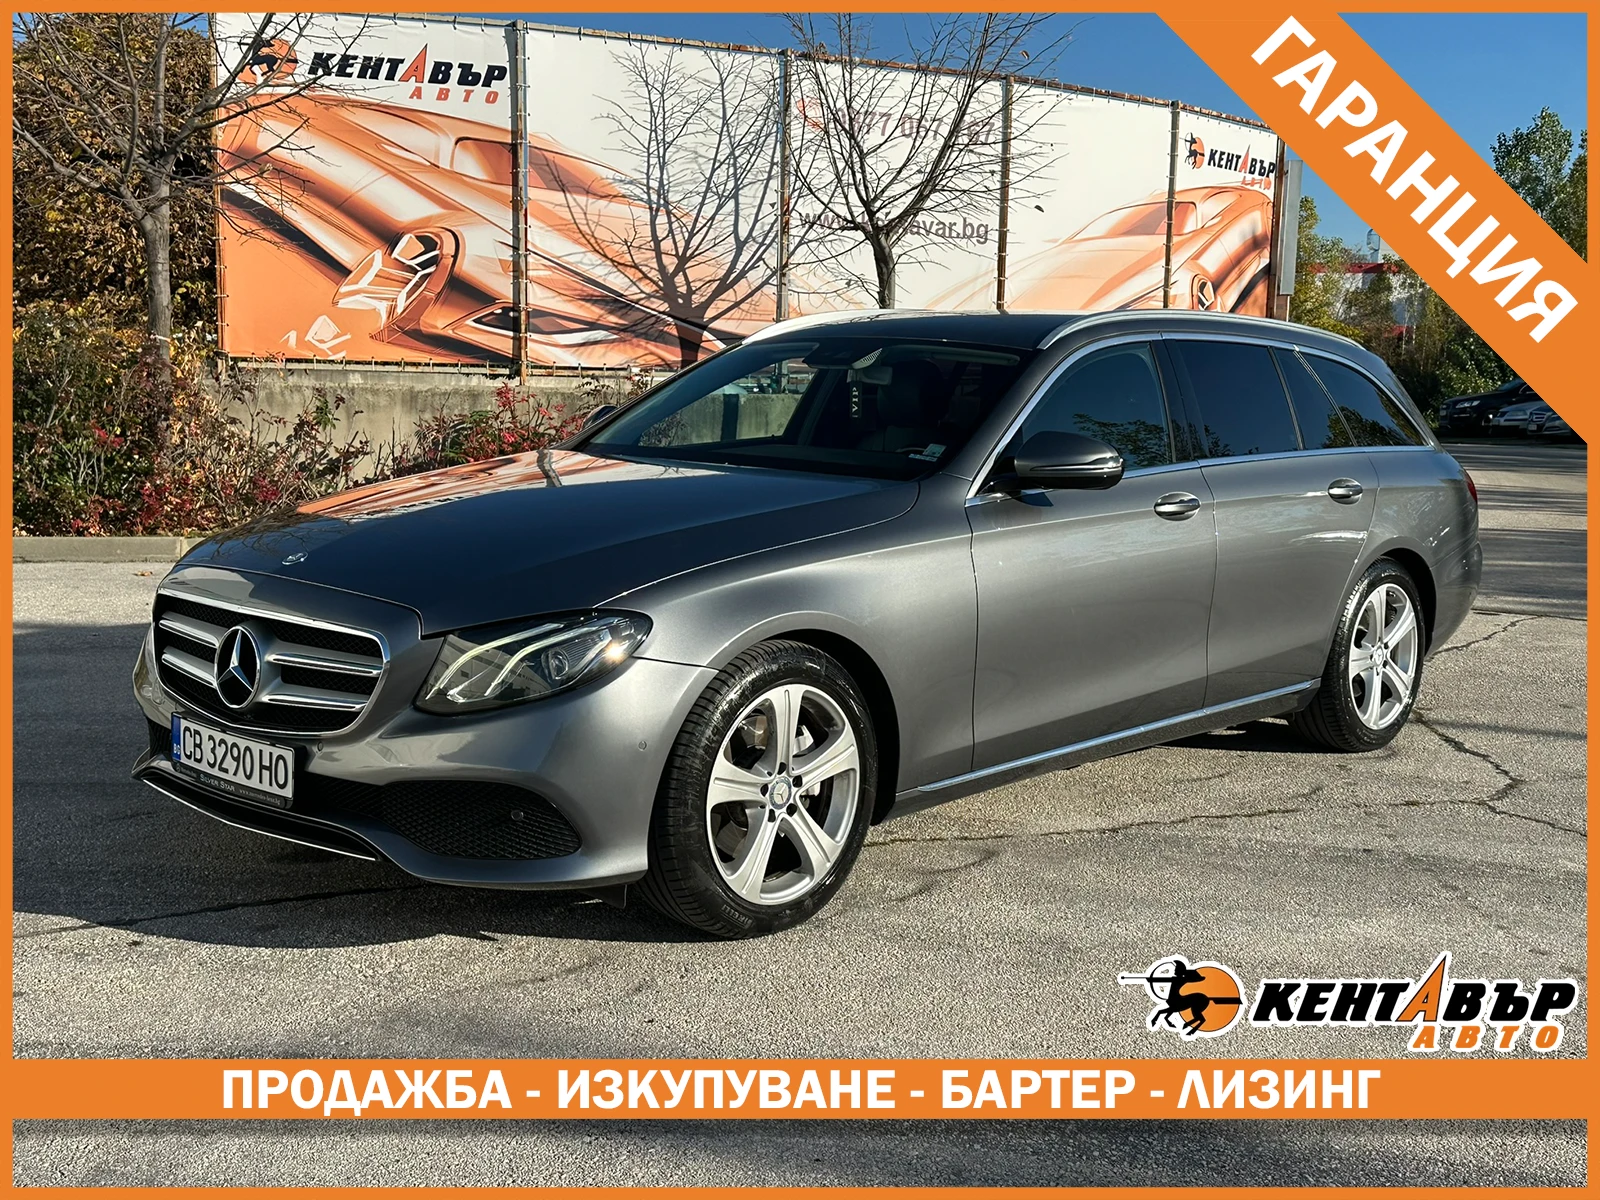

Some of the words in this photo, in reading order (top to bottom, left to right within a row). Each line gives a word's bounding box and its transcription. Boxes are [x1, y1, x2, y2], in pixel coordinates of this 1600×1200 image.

[308, 43, 508, 88] КЕНТАВЪР
[409, 86, 499, 105] АВТО
[1207, 144, 1276, 178] КЕНТАВЪР
[207, 734, 254, 781] 3290
